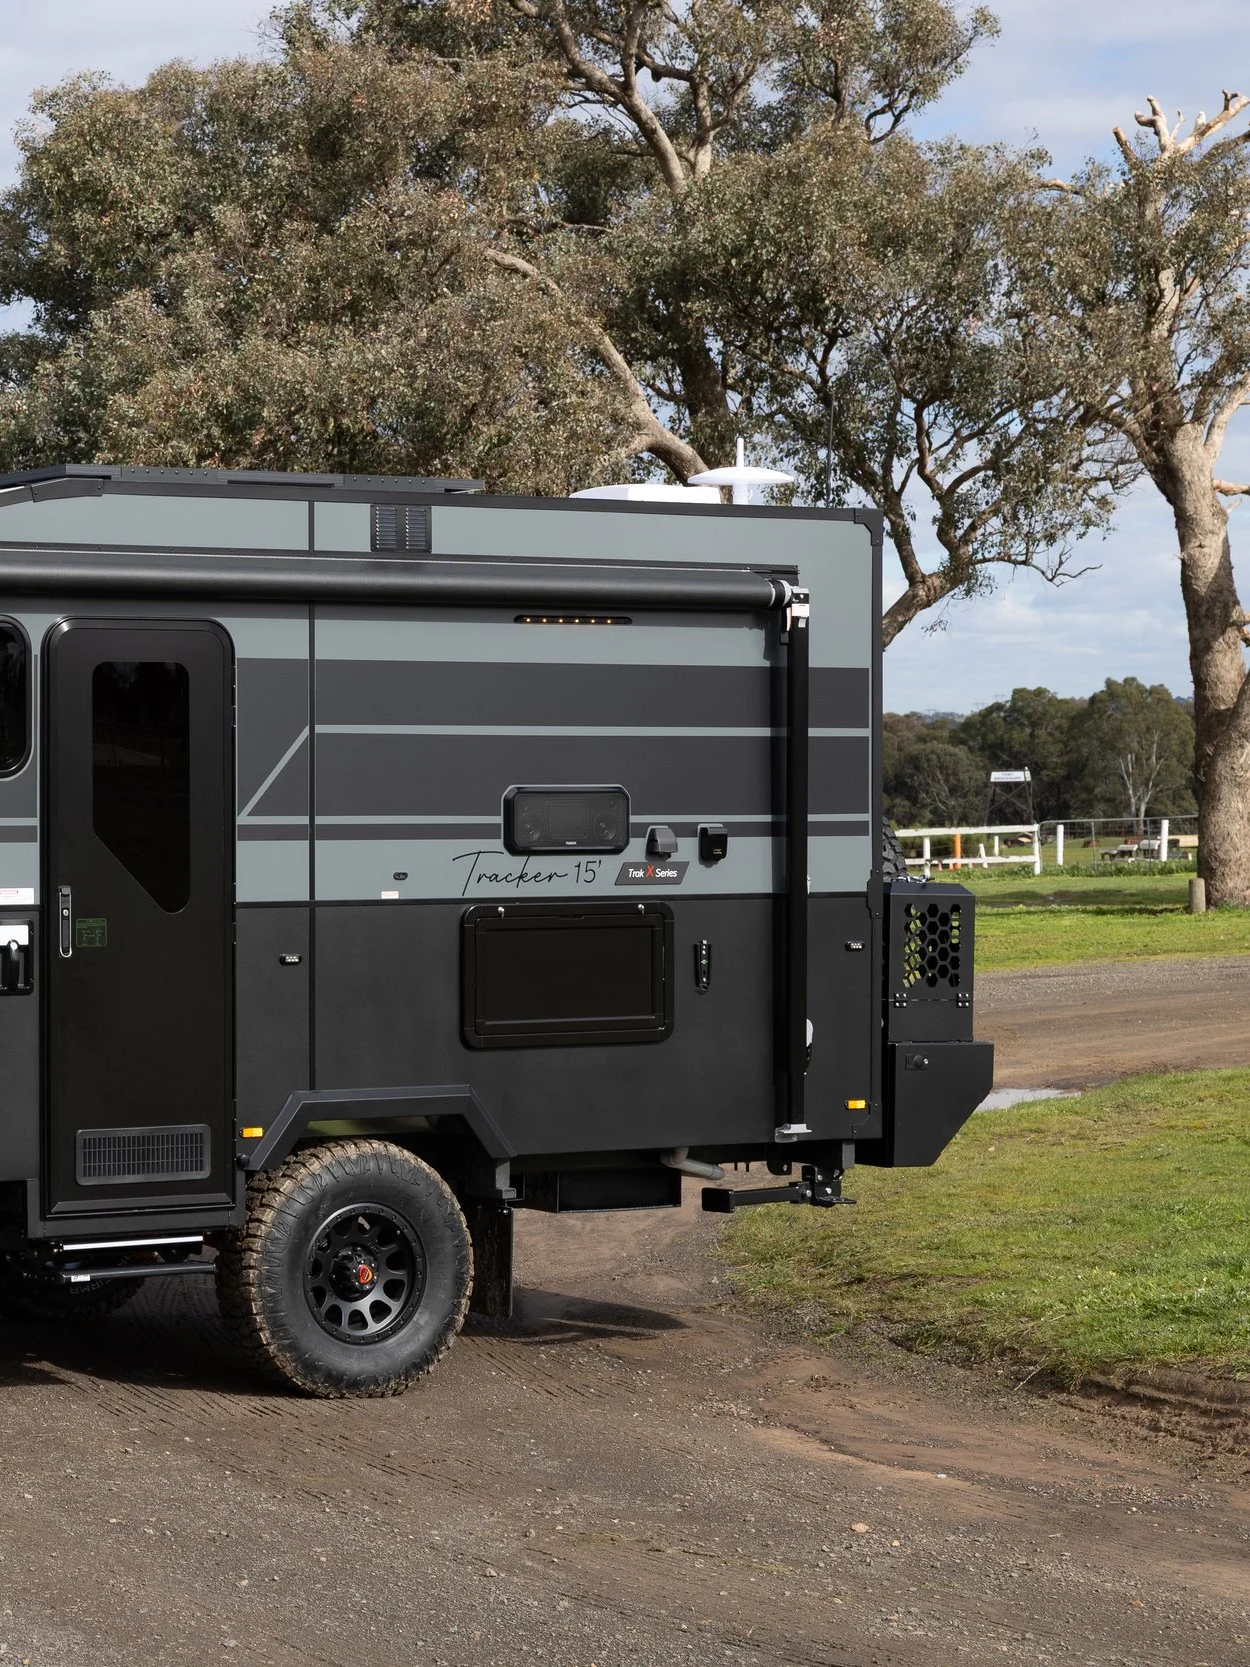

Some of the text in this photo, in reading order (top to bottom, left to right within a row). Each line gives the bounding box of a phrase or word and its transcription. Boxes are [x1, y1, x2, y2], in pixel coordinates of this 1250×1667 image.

[452, 850, 568, 897] Tracker
[628, 865, 678, 879] Trak X Series
